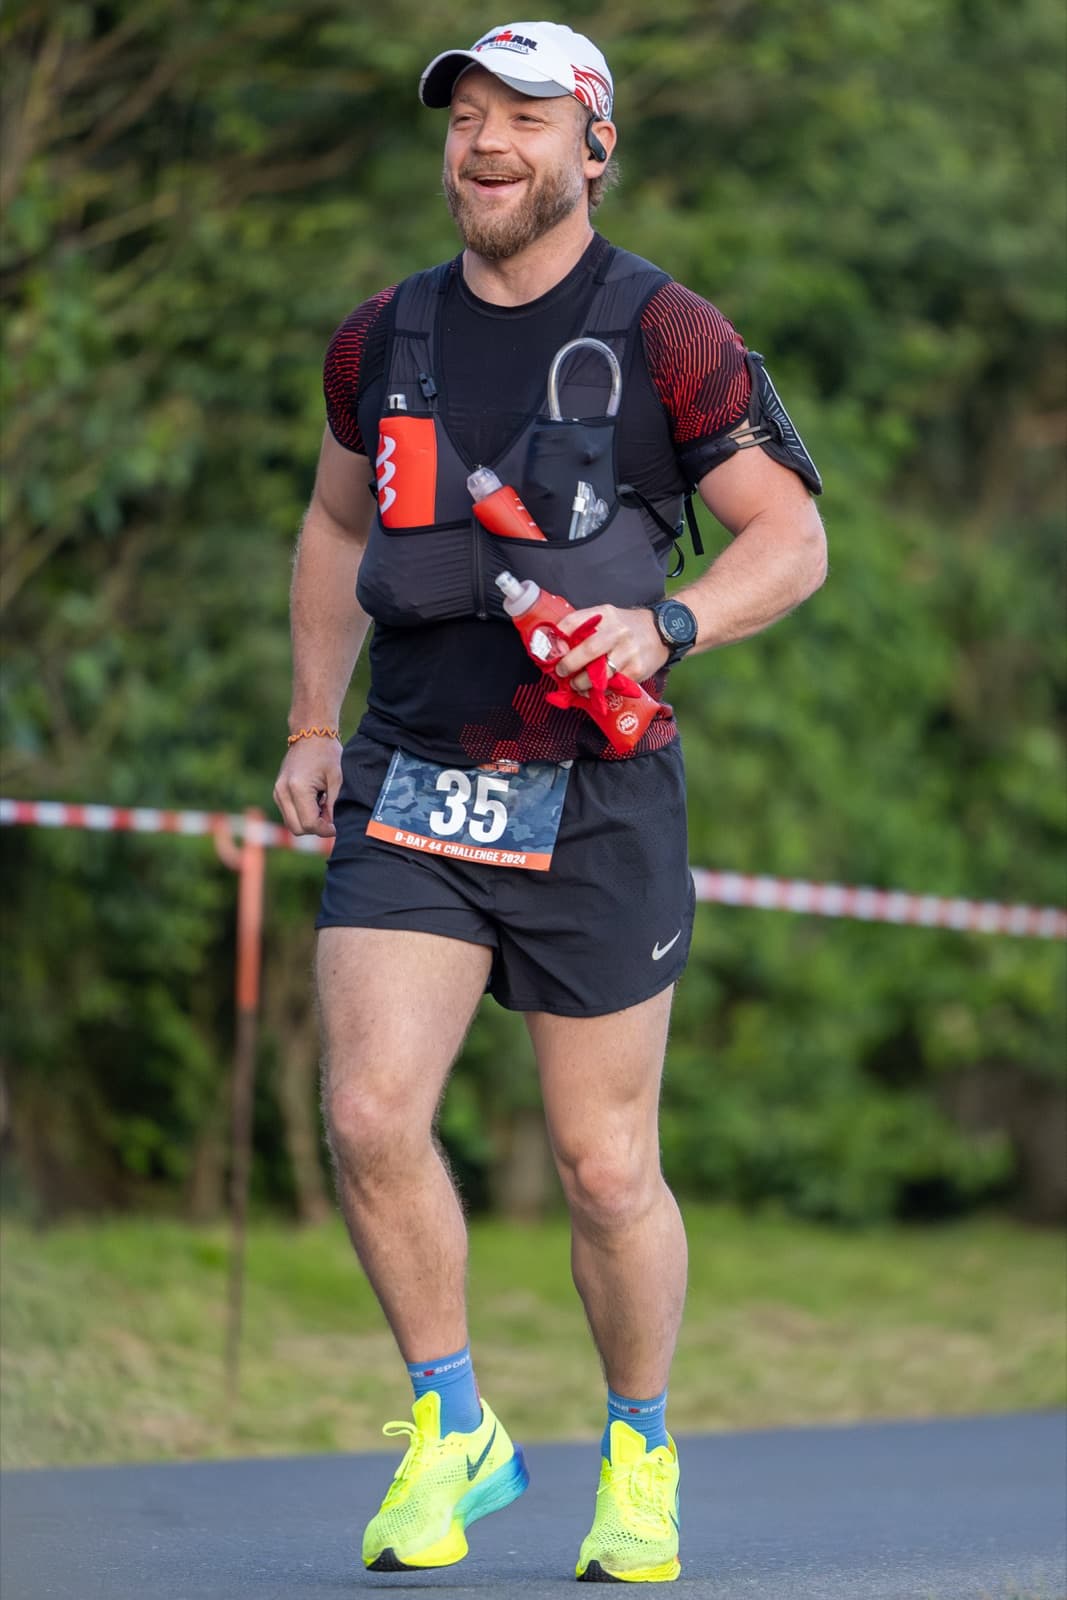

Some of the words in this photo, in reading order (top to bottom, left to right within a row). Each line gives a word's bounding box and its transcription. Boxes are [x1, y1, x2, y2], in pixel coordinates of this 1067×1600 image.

[429, 769, 509, 843] 35
[395, 832, 427, 848] D-DAY
[428, 842, 441, 852] 44
[443, 845, 500, 862] CHALLENGE
[500, 853, 526, 865] 2024
